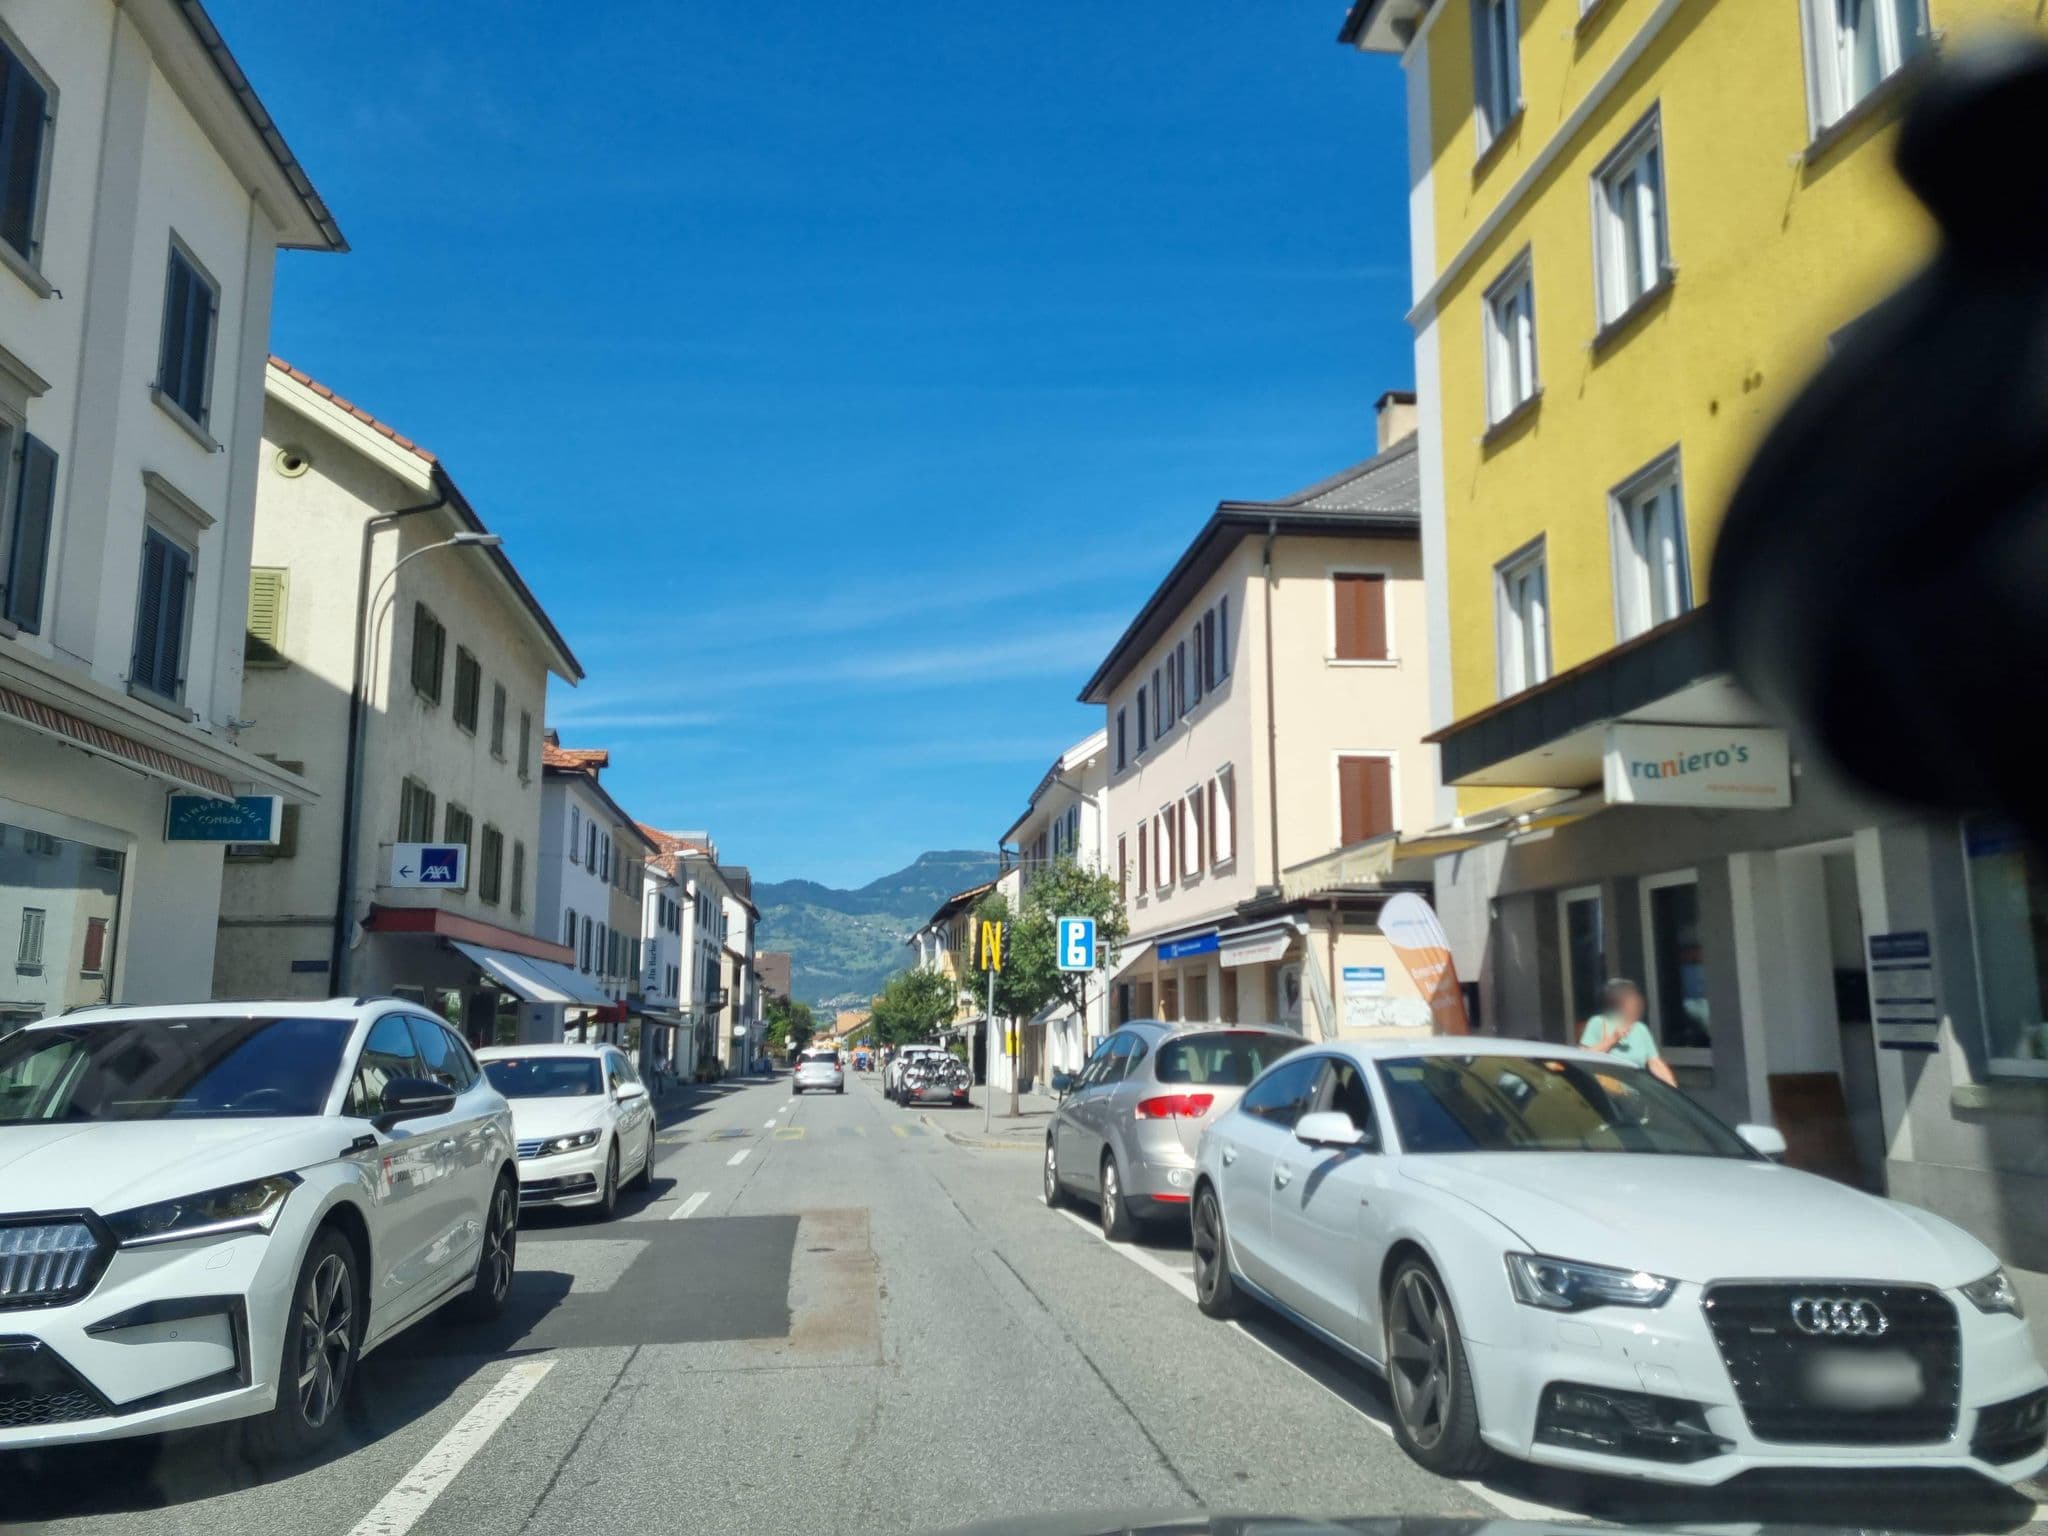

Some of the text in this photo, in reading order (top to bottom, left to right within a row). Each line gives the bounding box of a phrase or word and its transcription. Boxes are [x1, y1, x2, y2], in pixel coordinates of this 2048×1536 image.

[1632, 743, 1749, 779] raniero's
[198, 815, 242, 825] CONRAD
[420, 865, 451, 880] AXA
